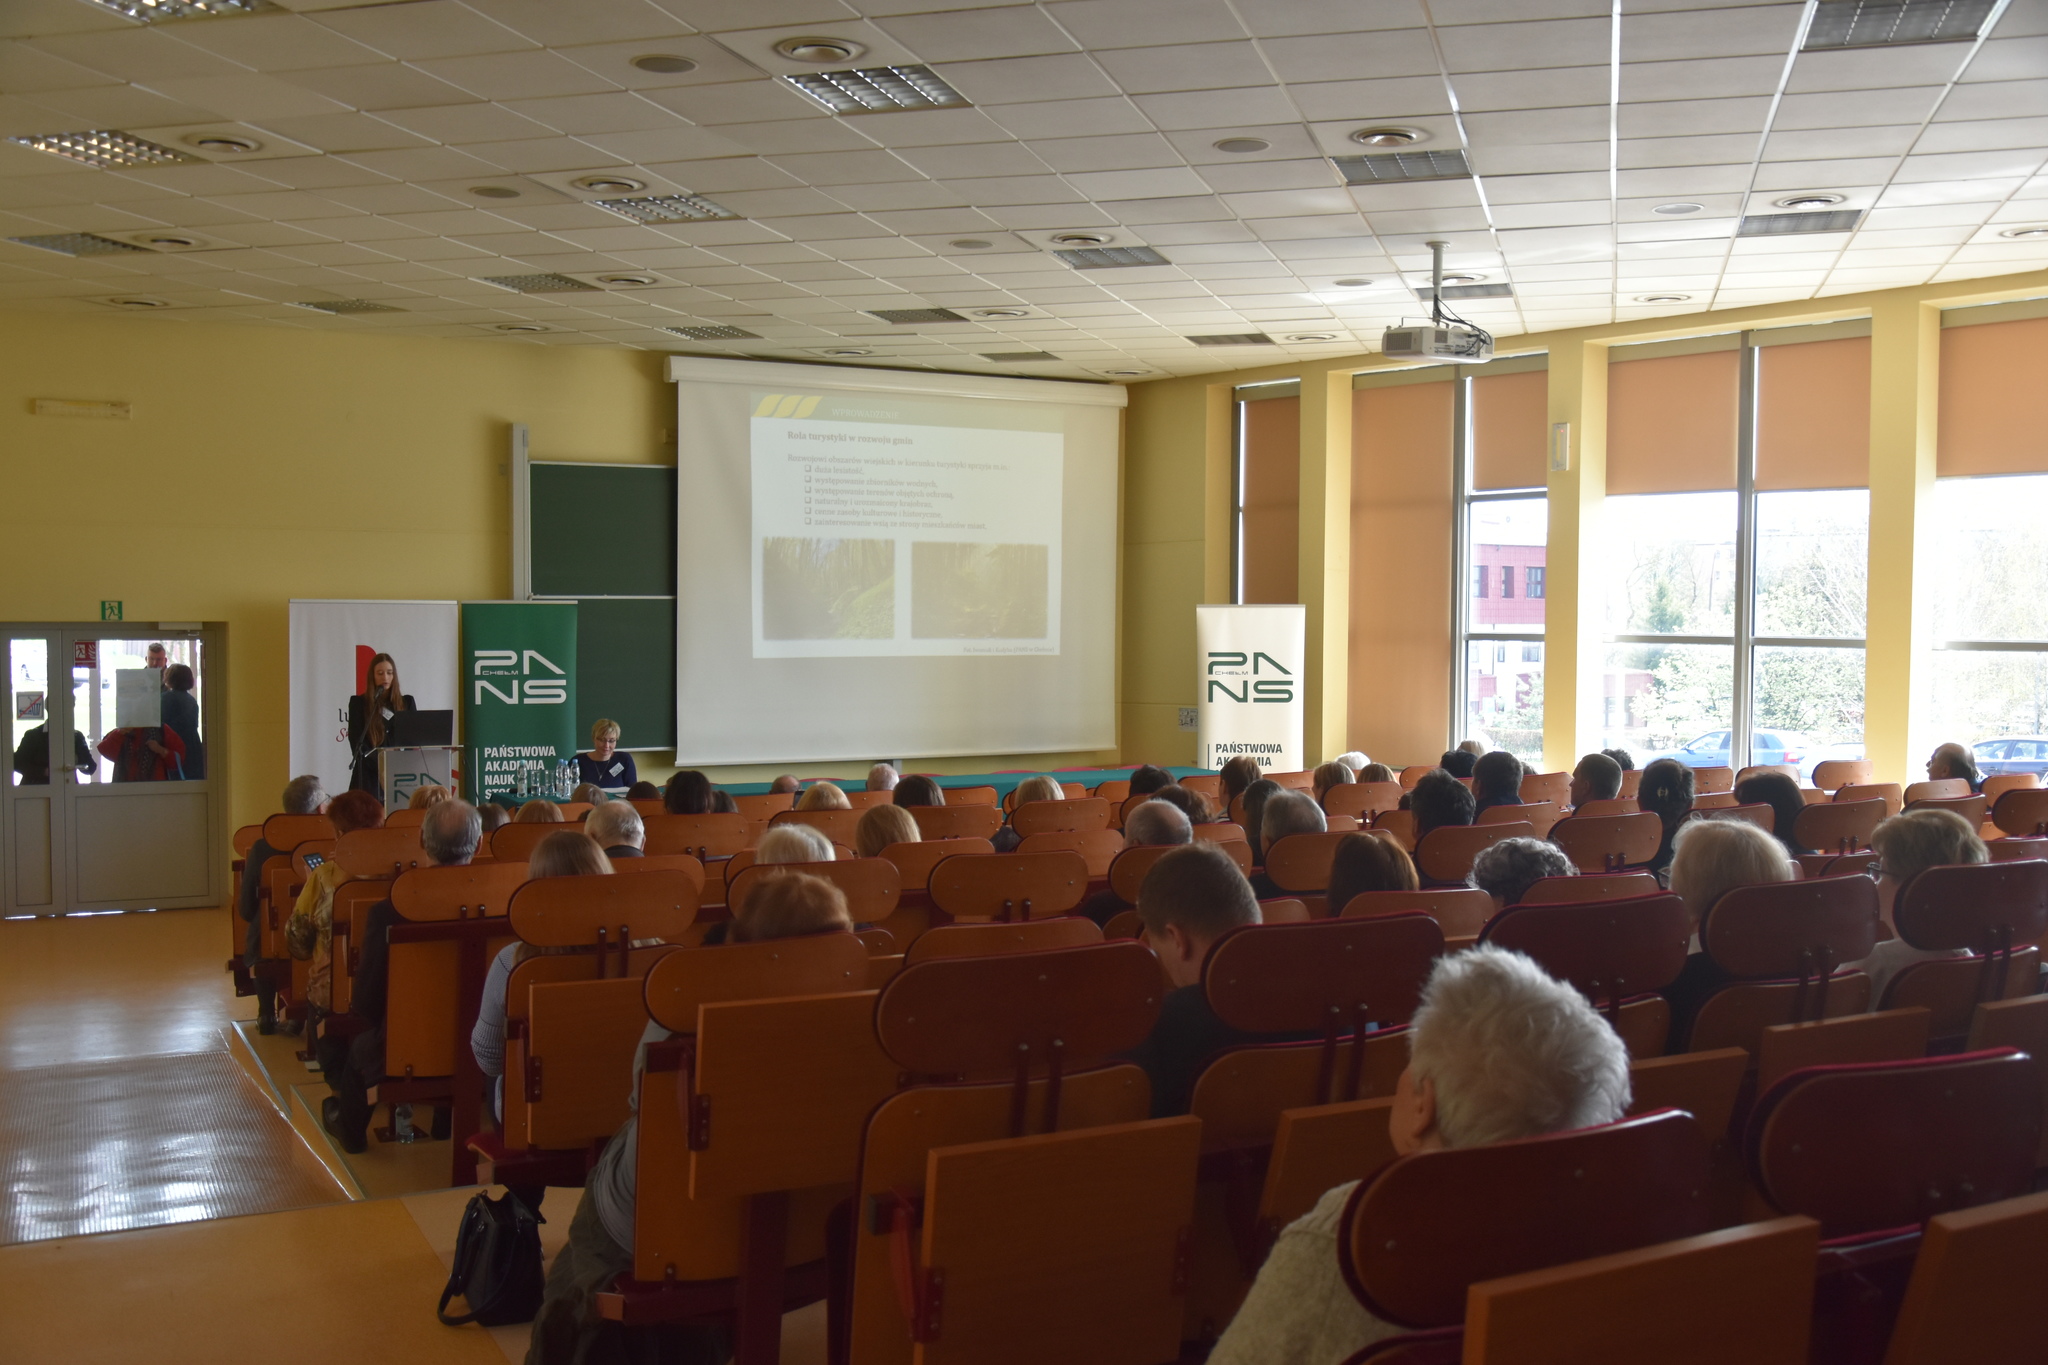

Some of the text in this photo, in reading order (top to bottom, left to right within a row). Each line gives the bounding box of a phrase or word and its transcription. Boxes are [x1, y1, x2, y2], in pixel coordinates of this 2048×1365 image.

[787, 431, 807, 440] Rola
[808, 432, 847, 443] turystyki
[857, 435, 891, 445] rozwoju
[892, 436, 913, 446] gmin
[787, 454, 827, 464] Rozwojowi
[828, 455, 862, 464] obszarów
[863, 457, 896, 466] wiejskich
[936, 461, 967, 470] turystyki
[814, 477, 865, 487] występowanie
[814, 488, 865, 497] występowanie
[484, 744, 556, 758] PAŃSTWOWA
[1215, 741, 1283, 753] PAŃSTWOWA
[1216, 756, 1272, 767] AKMIA
[484, 774, 515, 786] NAUK
